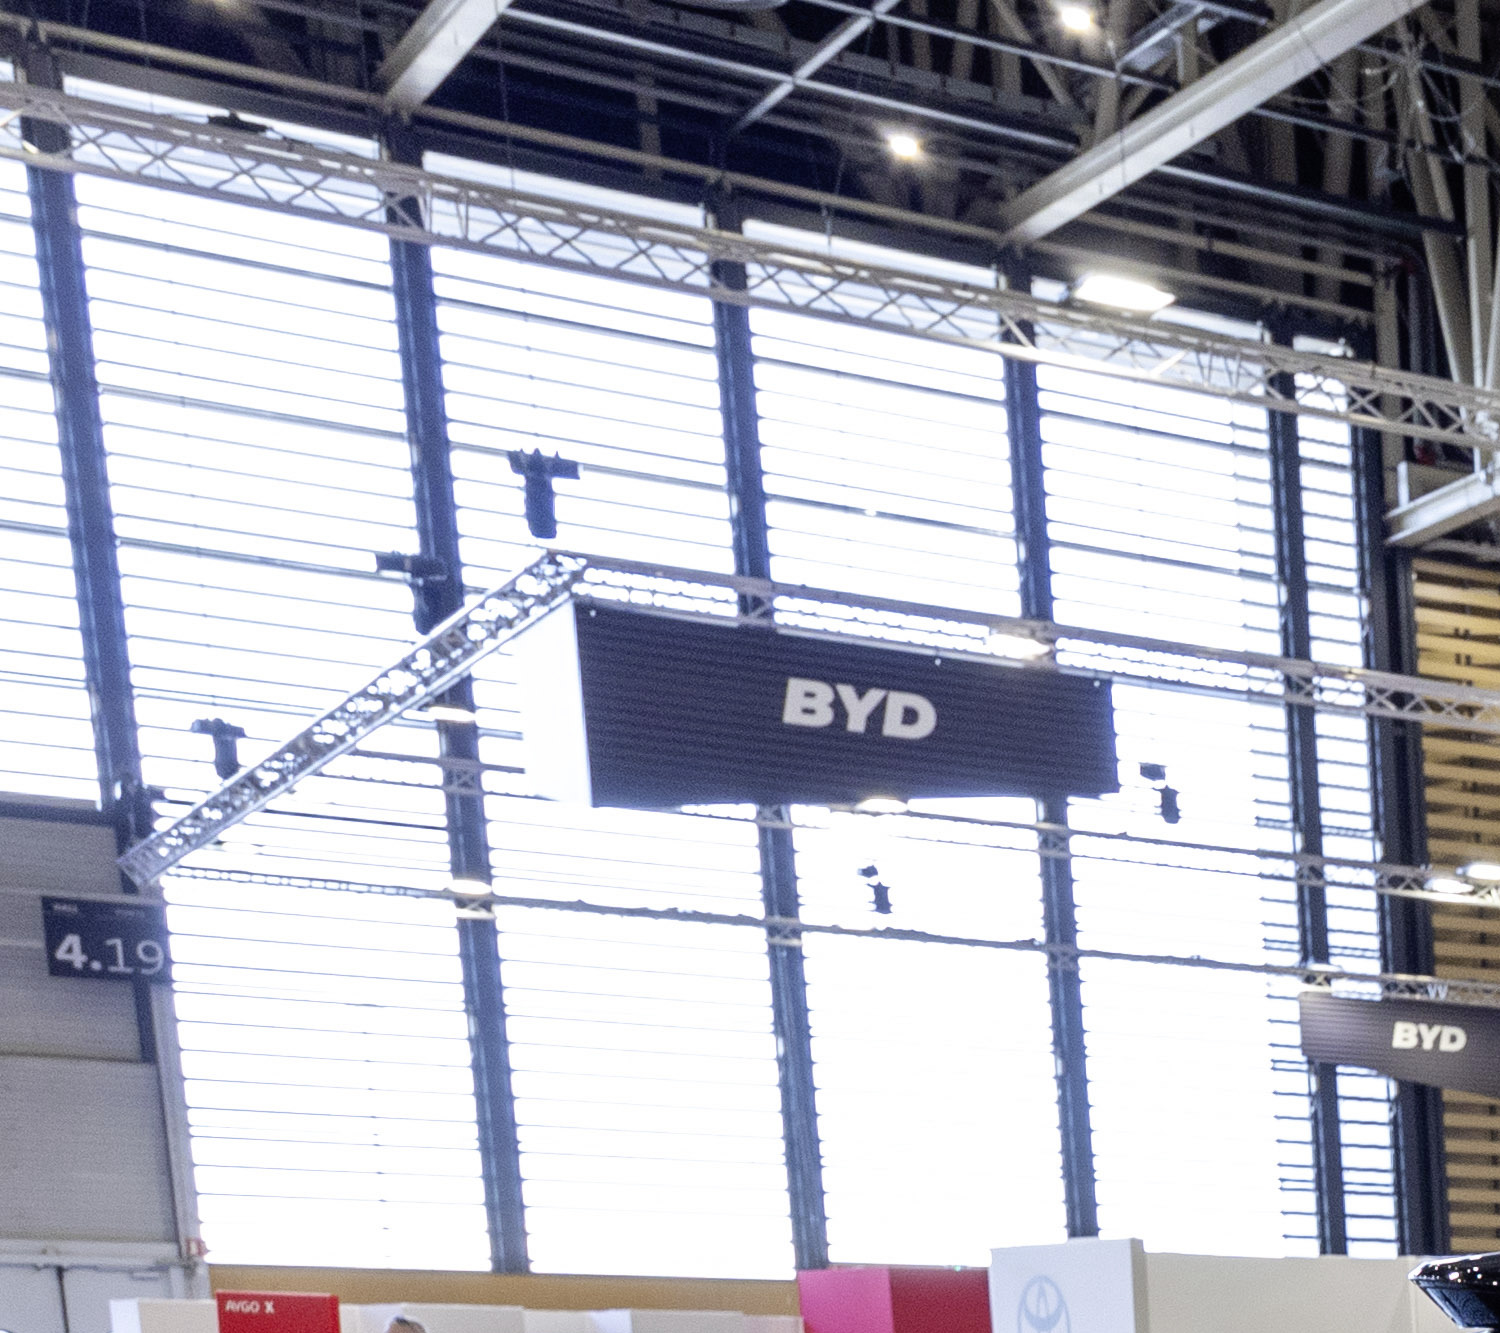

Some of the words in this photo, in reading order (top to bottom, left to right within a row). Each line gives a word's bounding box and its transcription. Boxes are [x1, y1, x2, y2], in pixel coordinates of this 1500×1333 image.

[781, 676, 938, 740] BYD
[54, 933, 165, 976] 4.19
[1391, 1020, 1468, 1053] BYD
